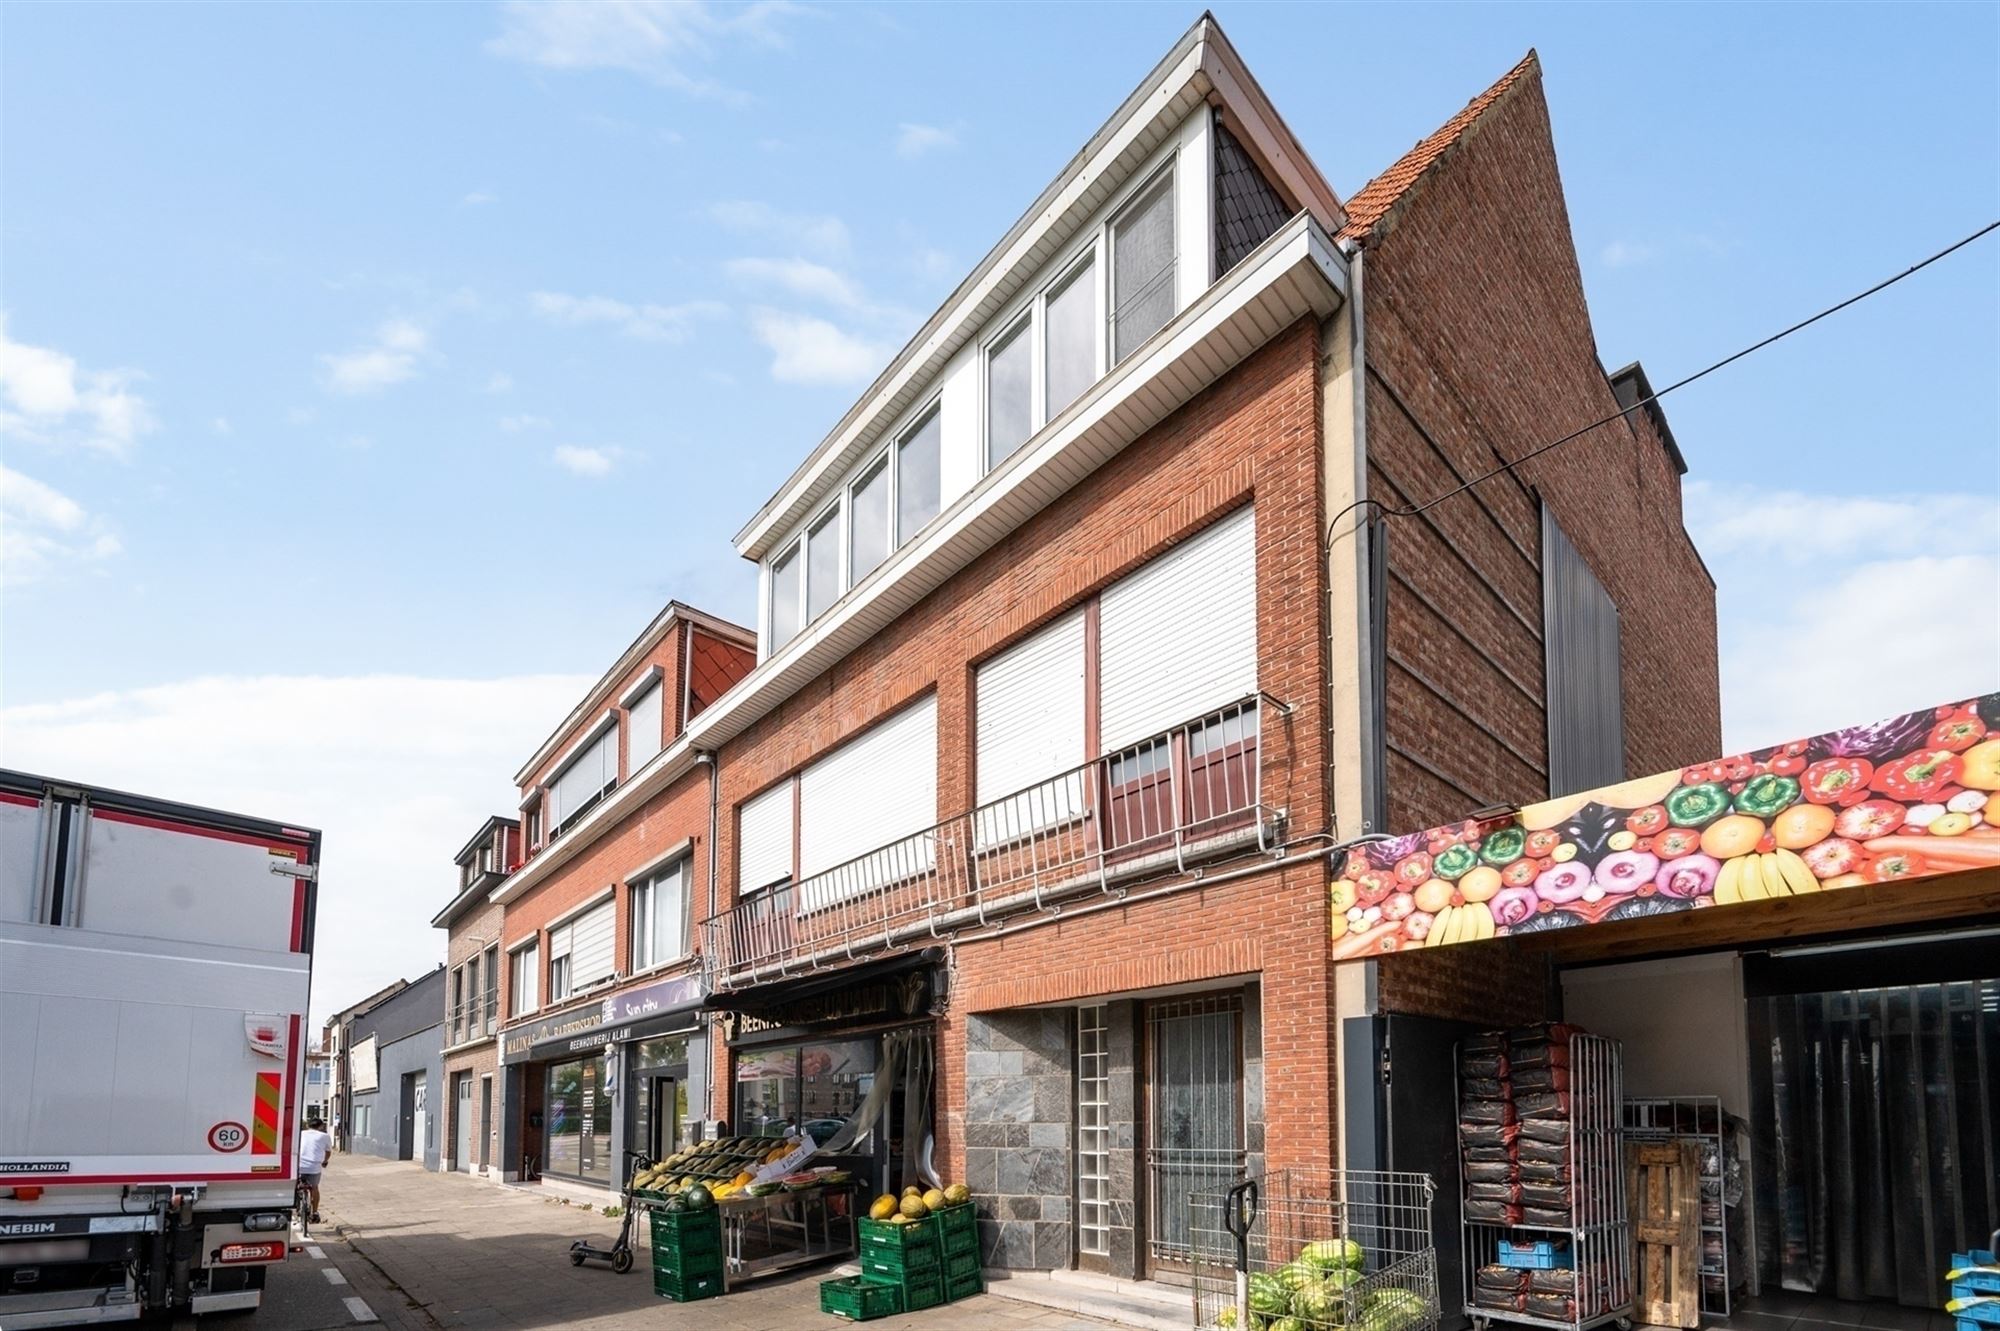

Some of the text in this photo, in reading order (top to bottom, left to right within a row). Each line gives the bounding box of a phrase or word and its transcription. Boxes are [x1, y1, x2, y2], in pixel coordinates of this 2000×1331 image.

[570, 1028, 631, 1050] BEENHOUWERIJ ALAMI
[219, 1130, 240, 1141] 60
[0, 1223, 56, 1234] NEBIM
